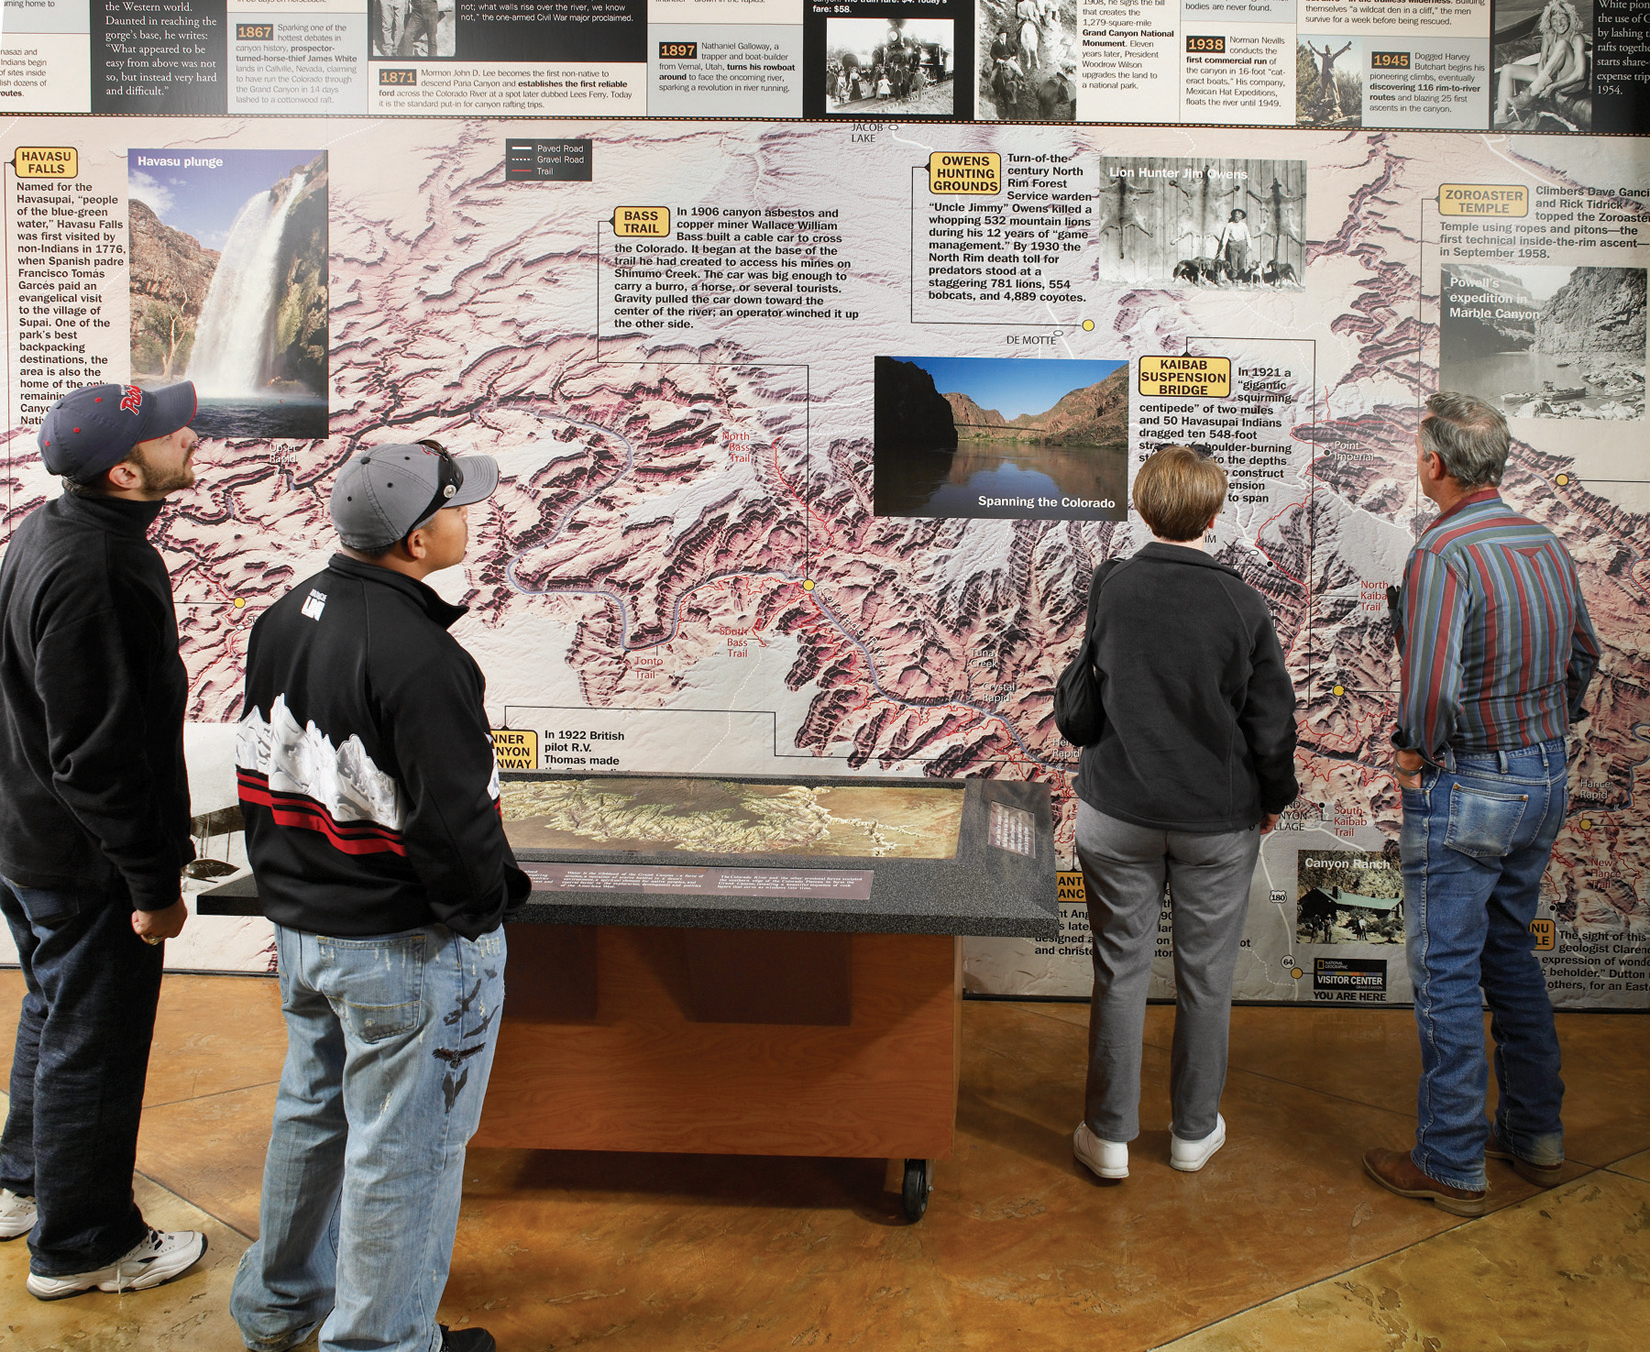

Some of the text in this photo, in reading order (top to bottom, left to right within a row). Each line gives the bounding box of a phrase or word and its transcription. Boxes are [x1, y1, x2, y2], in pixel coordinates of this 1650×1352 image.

[105, 1, 193, 12] the Western world.
[812, 4, 852, 13] fare: $58.
[239, 26, 271, 38] 1867
[1082, 28, 1174, 39] Grand Canyon National
[1188, 38, 1223, 50] 1938
[1229, 36, 1285, 45] Norman Nevills
[661, 44, 695, 56] 1897
[307, 54, 333, 62] James
[334, 55, 358, 63] White
[1204, 57, 1252, 65] commercial
[1374, 54, 1408, 66] 1945
[659, 62, 795, 71] from Vernal, Utah, turns his rowboat
[381, 71, 415, 83] 1871
[106, 85, 123, 95] and
[1369, 82, 1481, 93] discovering 116 rim-to-river
[1598, 85, 1623, 95] 1954.
[851, 122, 883, 132] JACOB
[851, 133, 875, 143] LAKE
[537, 144, 584, 153] Paved Road
[21, 151, 71, 162] HAVASU
[537, 155, 584, 164] Gravel Road
[942, 155, 990, 166] OWENS
[138, 156, 223, 169] Havasu plunge
[28, 163, 65, 174] FALLS
[536, 167, 553, 176] Trail
[937, 168, 995, 179] HUNTING
[1007, 166, 1083, 178] century North
[1109, 166, 1248, 180] Lion Hunter Jim Owens
[16, 181, 93, 192] Named for the
[933, 180, 998, 192] GROUNDS
[1007, 178, 1067, 188] Rim Forest
[1007, 190, 1049, 201] Service
[1445, 189, 1523, 201] ZOROASTER
[1536, 185, 1650, 198] Climbers Dave Ganci
[16, 194, 74, 206] Havasupai,
[16, 206, 108, 219] of the blue-green
[677, 206, 839, 219] In 1906 canyon asbestos and
[1459, 203, 1509, 214] TEMPLE
[624, 210, 658, 221] BASS
[623, 223, 659, 234] TRAIL
[1450, 277, 1499, 288] Powell's
[1449, 292, 1528, 305] expedition in
[1449, 307, 1541, 321] Marble Canyon
[1006, 335, 1056, 345] DE MOTTE
[1160, 359, 1207, 370] KAIBAB
[1141, 371, 1226, 383] SUSPENSION
[1238, 367, 1291, 378] In 1921 a
[1159, 384, 1208, 396] BRIDGE
[722, 432, 750, 441] North
[1139, 428, 1257, 440] dragged ten 548-foot
[729, 443, 750, 452] Bass
[1335, 441, 1359, 450] Point
[730, 454, 750, 463] Trail
[978, 495, 1115, 509] Spanning the Colorado
[1361, 580, 1388, 589] North
[1361, 591, 1387, 600] Kaiba
[1361, 602, 1381, 611] Trail
[720, 627, 748, 636] South
[727, 638, 748, 647] Bass
[728, 649, 748, 658] Trail
[635, 657, 664, 666] Tonto
[635, 671, 655, 680] Trail
[493, 734, 524, 744] NNER
[544, 730, 624, 741] In 1922 British
[496, 747, 530, 757] NYON
[544, 742, 592, 753] pilot R.V.
[544, 754, 620, 766] Thomas made
[1334, 817, 1367, 826] Kaibab
[1334, 828, 1354, 837] Trail
[1305, 857, 1391, 870] Canyon Ranch
[1591, 858, 1613, 867] New
[1272, 893, 1286, 902] 180
[1559, 930, 1579, 940] The
[1582, 931, 1609, 943] sight
[1612, 932, 1624, 941] of
[1627, 931, 1647, 942] this
[1283, 958, 1293, 967] 64
[1317, 975, 1383, 985] VISITOR CENTER
[1313, 991, 1387, 1001] YOU ARE HERE
